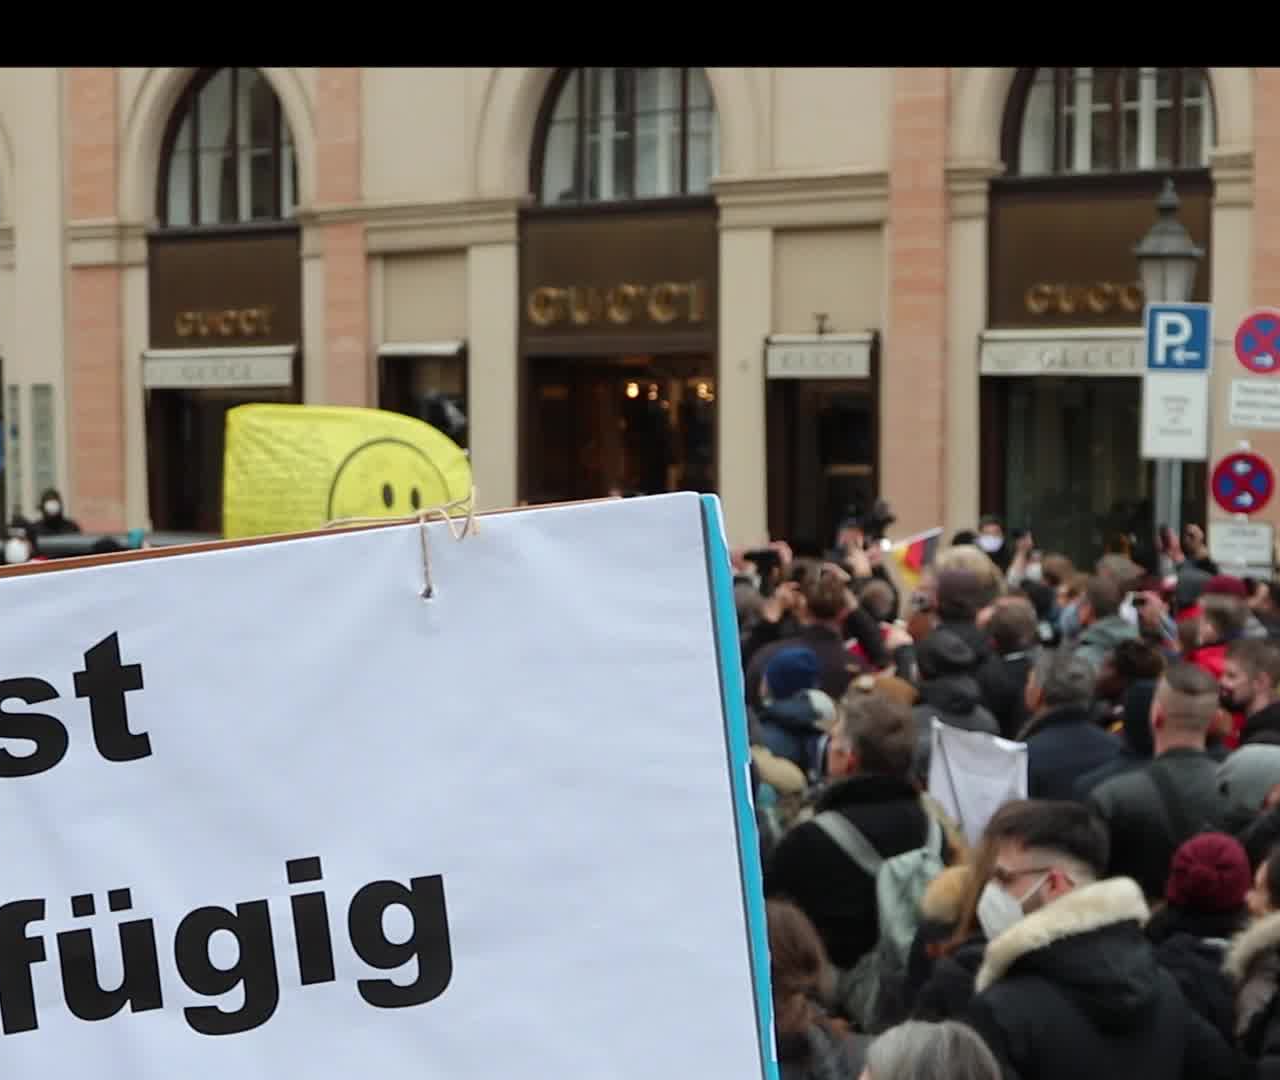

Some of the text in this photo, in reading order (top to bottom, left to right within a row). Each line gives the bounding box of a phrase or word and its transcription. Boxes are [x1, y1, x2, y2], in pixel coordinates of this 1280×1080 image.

[527, 283, 706, 325] GUCCI
[1023, 283, 1144, 313] GUCC
[1154, 310, 1194, 366] P
